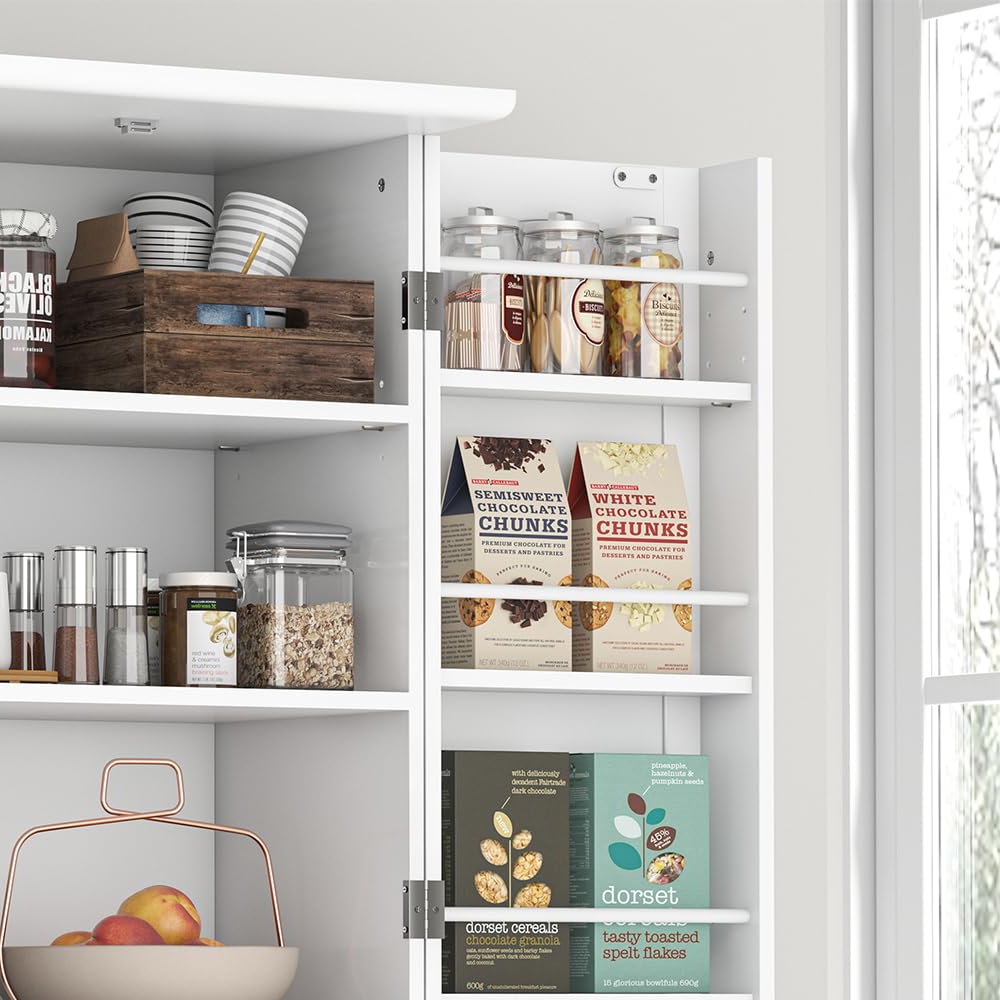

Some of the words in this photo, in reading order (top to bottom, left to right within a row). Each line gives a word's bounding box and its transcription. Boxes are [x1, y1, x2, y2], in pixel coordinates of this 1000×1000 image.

[474, 490, 563, 502] SEMISWEET
[592, 493, 656, 506] WHITE
[477, 503, 567, 515] CHOCOLATE
[595, 508, 687, 520] CHOCOLATE
[478, 516, 568, 534] CHUNKS
[596, 520, 688, 538] CHUNKS
[651, 762, 687, 770] pineapple,
[526, 770, 560, 778] deliciously
[651, 778, 683, 786] pumpkin
[602, 885, 679, 905] dorset
[466, 921, 509, 934] dorset
[511, 922, 559, 934] cereals
[466, 934, 517, 946] chocolate
[519, 934, 560, 947] granola
[602, 931, 641, 945] tasty
[645, 931, 700, 943] toasted
[603, 946, 640, 961] spelt
[643, 947, 687, 959] flakes
[466, 982, 484, 990] 600g
[613, 979, 644, 988] glorious
[679, 979, 699, 988] 690g
